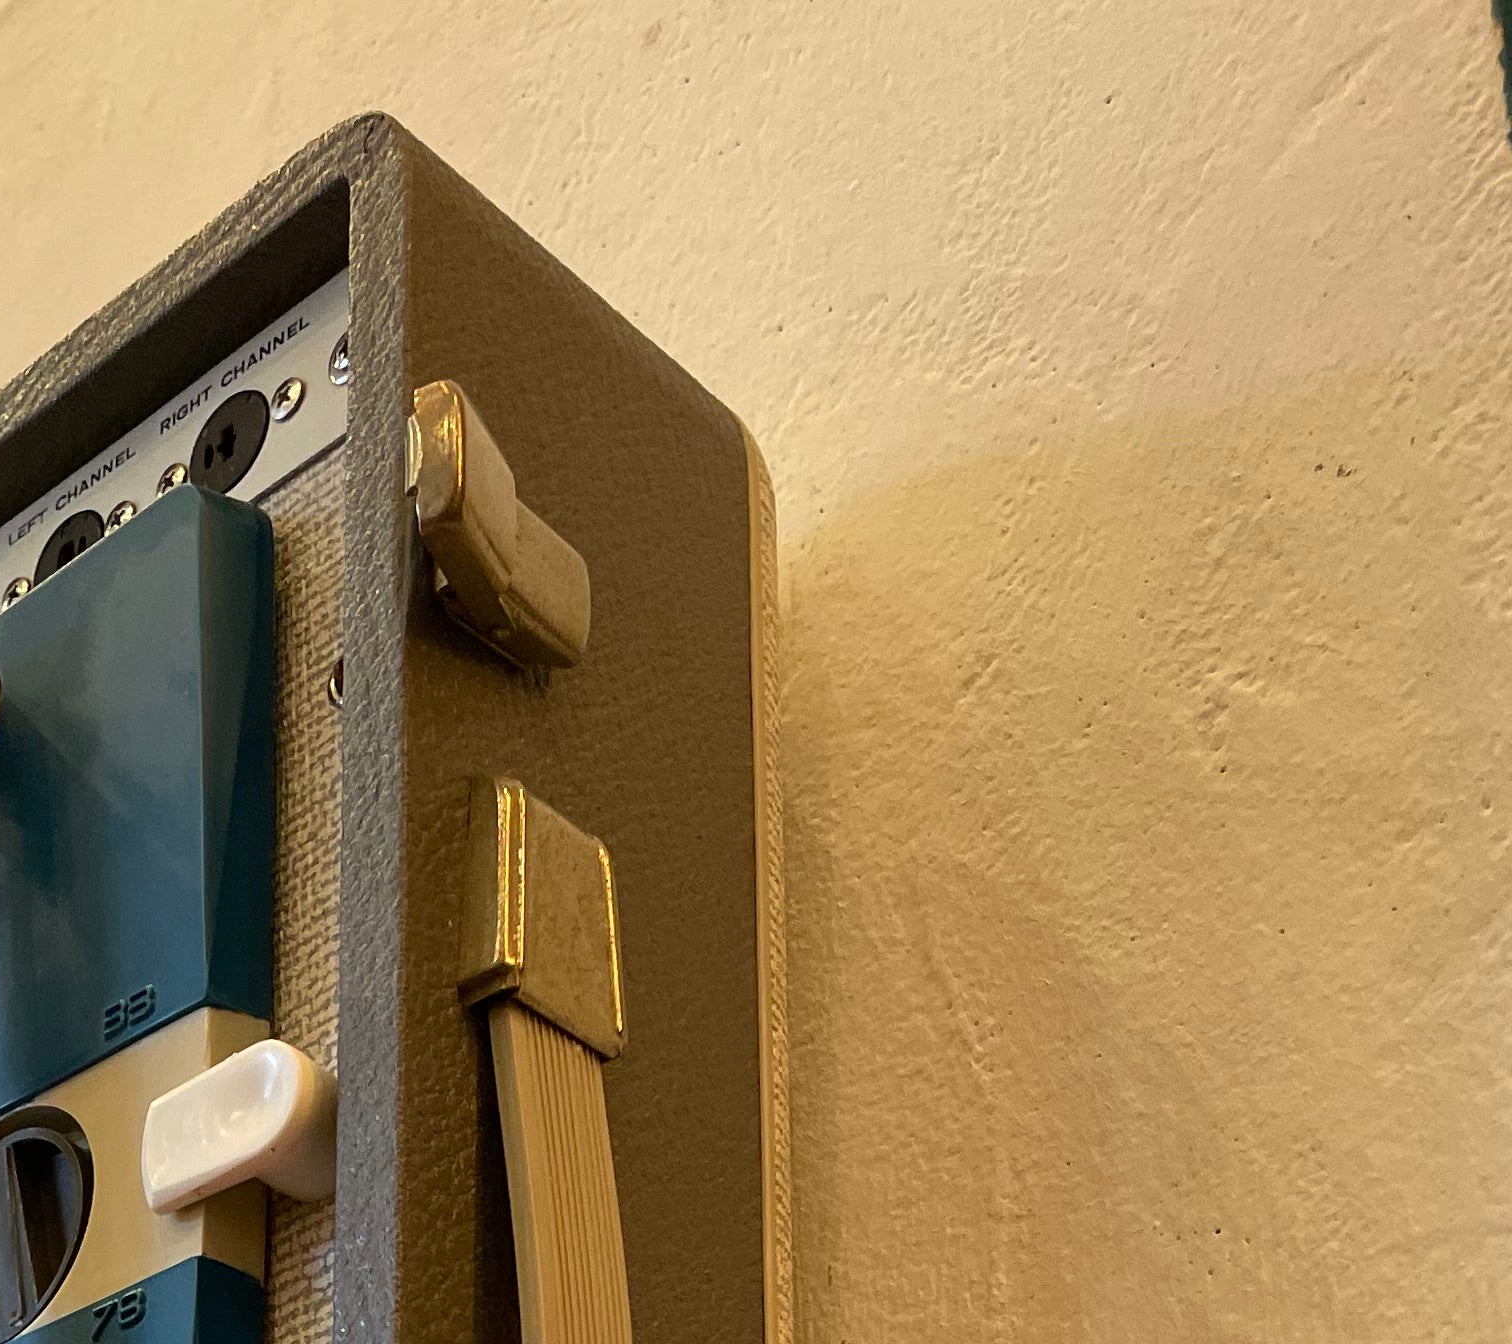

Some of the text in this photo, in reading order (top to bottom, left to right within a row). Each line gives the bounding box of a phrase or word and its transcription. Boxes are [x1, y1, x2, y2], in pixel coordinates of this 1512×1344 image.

[159, 317, 310, 435] RIGHT CHANNEL
[7, 446, 137, 547] LEFT CHANNEL
[103, 983, 157, 1042] 33
[90, 1287, 148, 1344] 78
